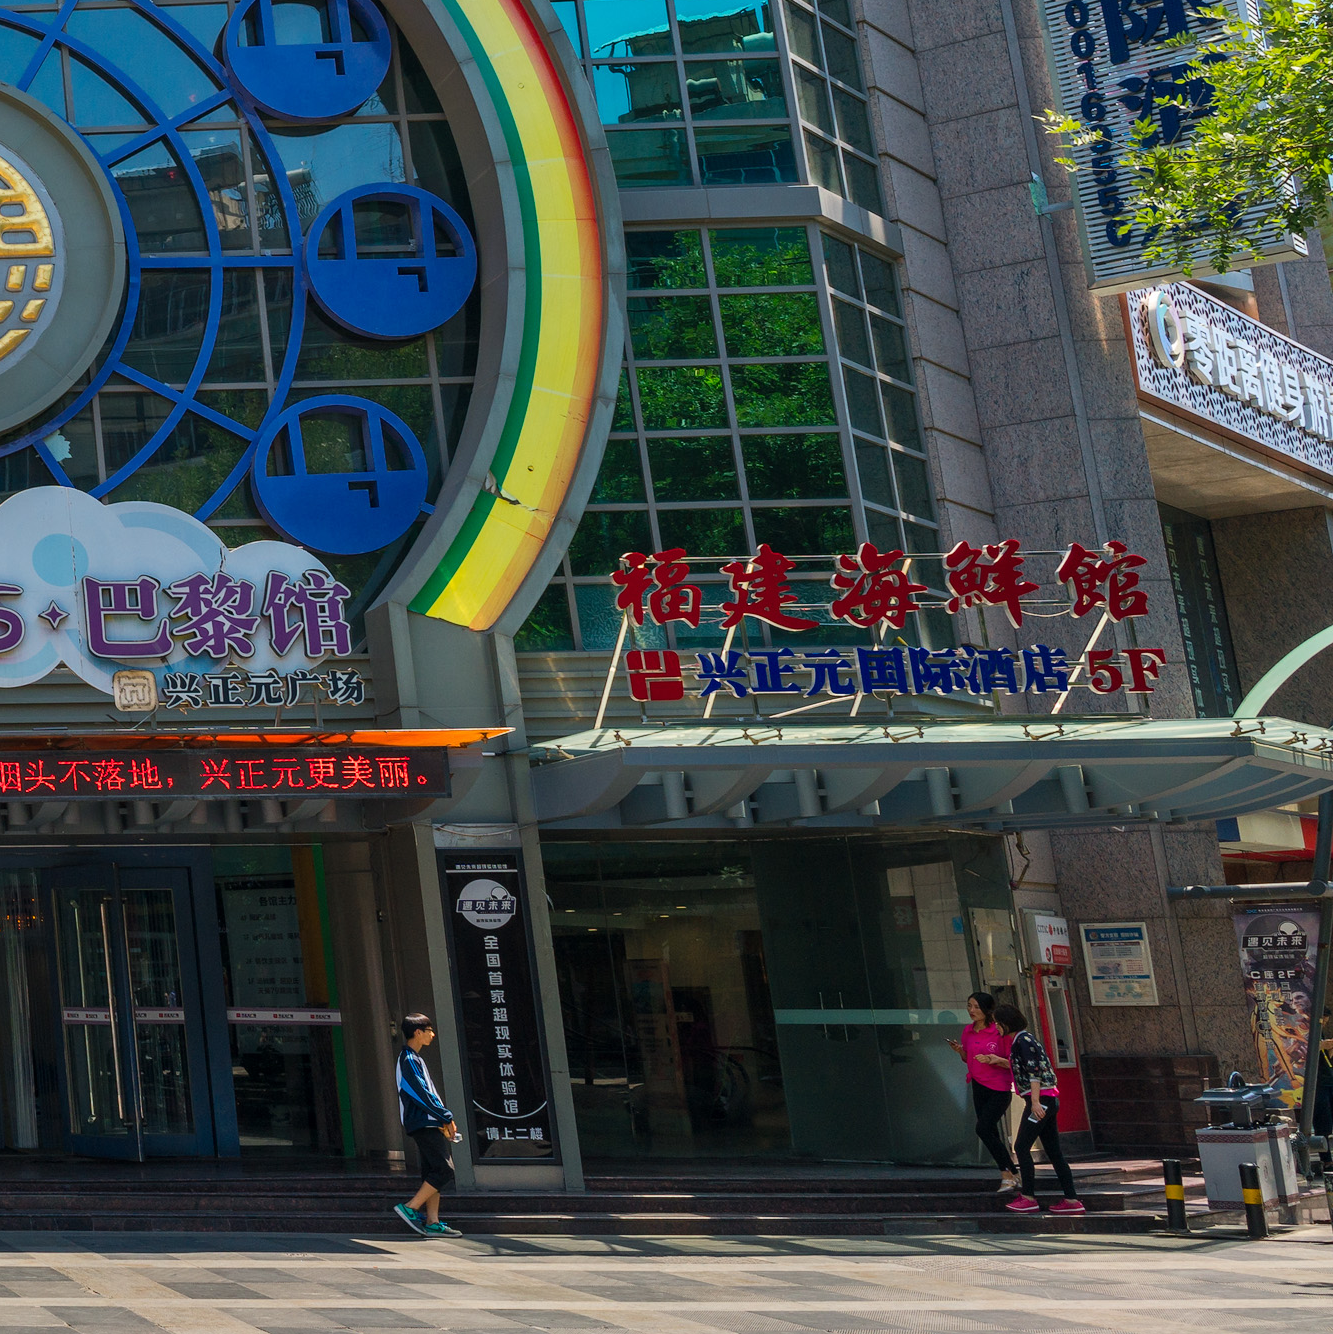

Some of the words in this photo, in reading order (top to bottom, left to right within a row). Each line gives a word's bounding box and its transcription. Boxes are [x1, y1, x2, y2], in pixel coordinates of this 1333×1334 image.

[1180, 309, 1333, 444] 零距离健身游
[82, 570, 353, 659] 巴黎馆
[163, 669, 366, 709] 兴正元广场
[694, 643, 1071, 699] 兴正元国际酒店
[1087, 647, 1167, 695] 5F
[462, 900, 512, 911] 遇见未来
[1247, 936, 1303, 948] 遇见未来
[483, 934, 519, 1114] 全国首家超现实体验馆
[486, 1126, 544, 1142] 请上二楼
